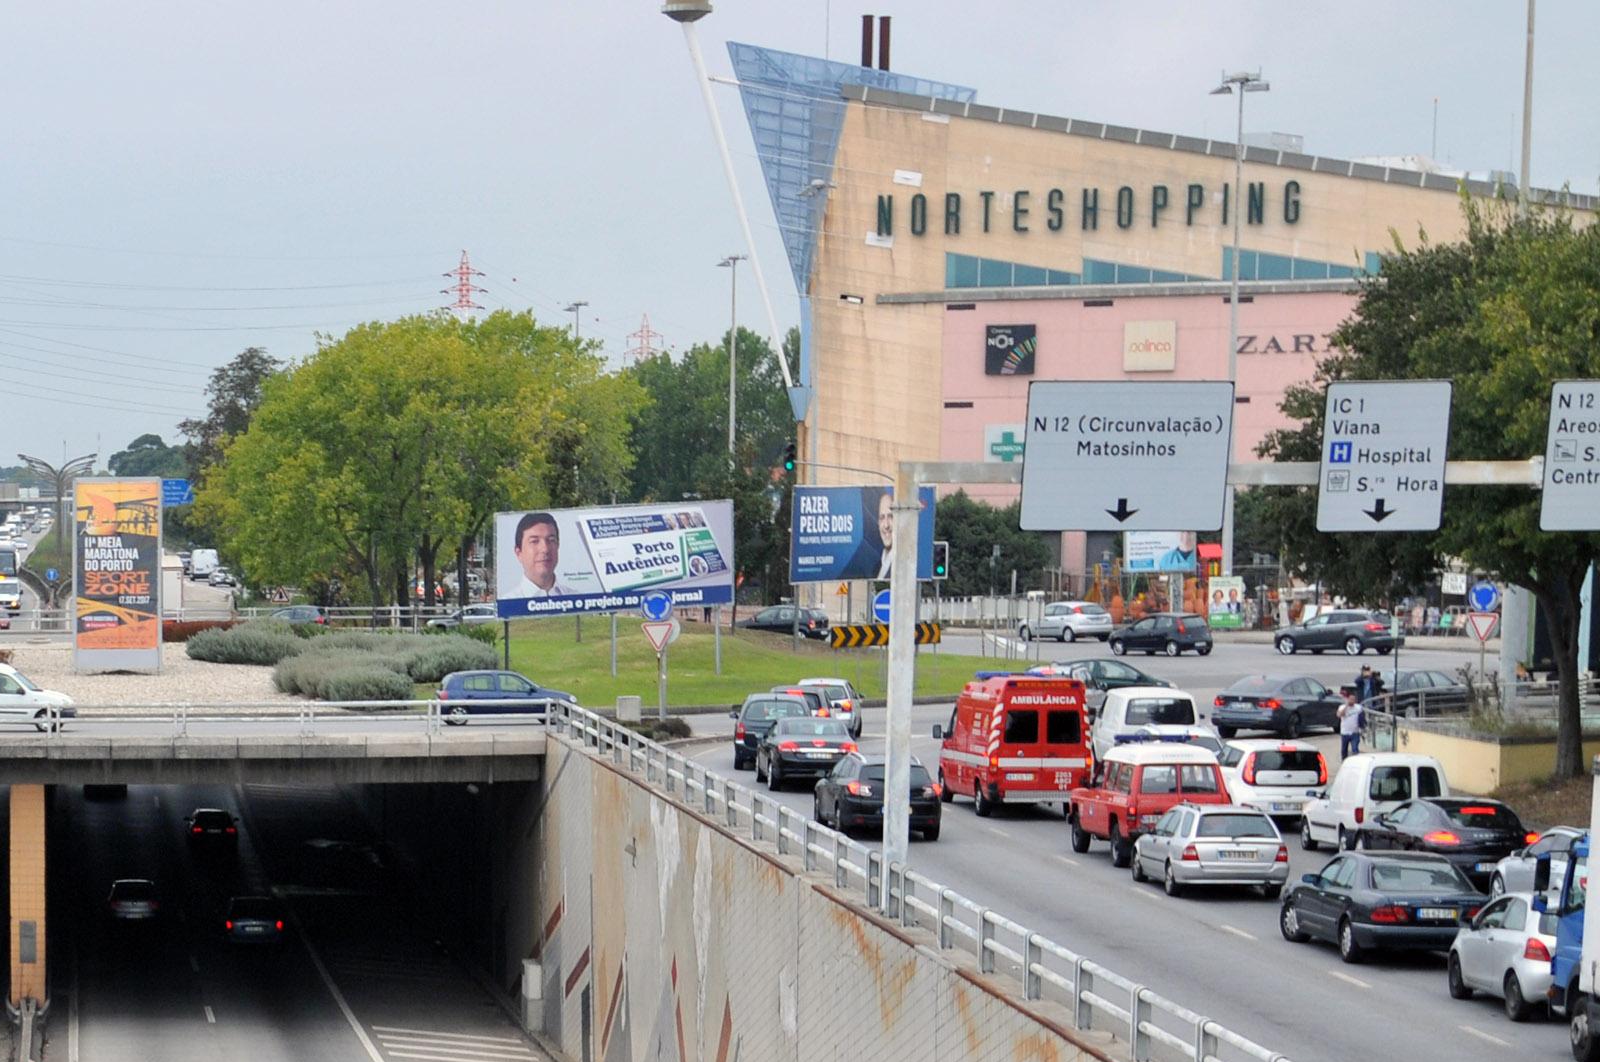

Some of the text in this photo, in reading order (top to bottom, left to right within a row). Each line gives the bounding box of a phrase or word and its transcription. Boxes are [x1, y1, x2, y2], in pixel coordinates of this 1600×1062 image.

[876, 178, 1304, 238] NORTESHOPPING
[988, 334, 1014, 349] NOS
[1333, 398, 1352, 414] IC
[1559, 393, 1595, 409] N 12
[1034, 416, 1047, 432] N
[1054, 416, 1070, 432] 12
[1332, 420, 1380, 435] Viana
[1557, 418, 1600, 433] Areo
[1076, 440, 1176, 456] Matosinhos
[1357, 447, 1431, 466] Hospital
[1396, 476, 1438, 492] Hora
[800, 495, 829, 514] FAZER
[800, 514, 853, 533] PELOS DOIS
[97, 536, 122, 548] MEIA
[632, 540, 674, 555] Porto
[84, 548, 139, 560] MARATONA
[84, 559, 133, 571] DO PORTO
[605, 554, 680, 575] Autêntico
[85, 571, 149, 583] SPORT
[85, 583, 150, 595] ZONE
[527, 598, 573, 612] Conheça
[575, 600, 583, 608] o
[584, 596, 623, 610] projeto
[624, 596, 639, 605] no
[671, 590, 703, 604] jornal
[1010, 694, 1077, 705] AMBULÂNCIA
